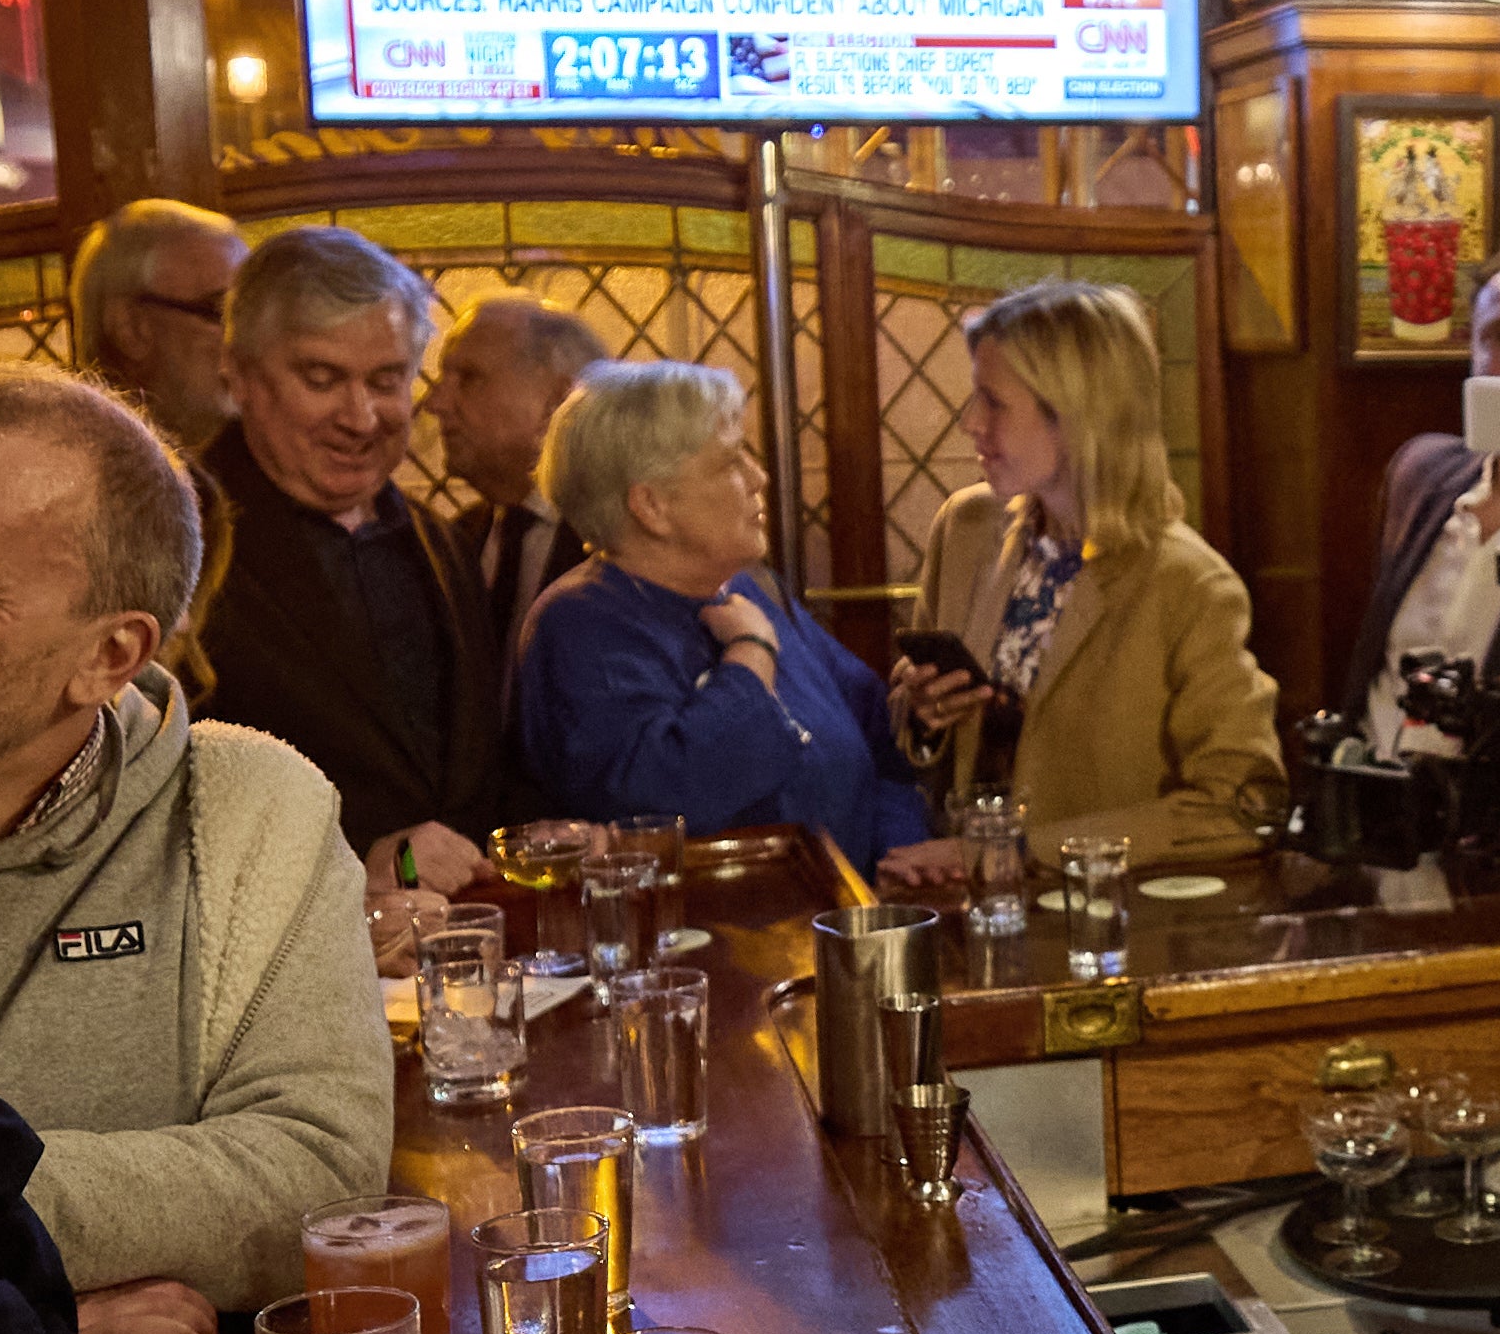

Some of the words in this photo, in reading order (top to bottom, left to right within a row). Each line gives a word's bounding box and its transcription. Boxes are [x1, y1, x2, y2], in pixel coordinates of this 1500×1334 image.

[1075, 19, 1149, 55] CNN
[383, 39, 447, 69] CNN
[551, 36, 709, 81] 2:07:13
[861, 75, 913, 96] BEFORE
[1098, 82, 1161, 96] ELECTION
[59, 927, 141, 956] FILA
